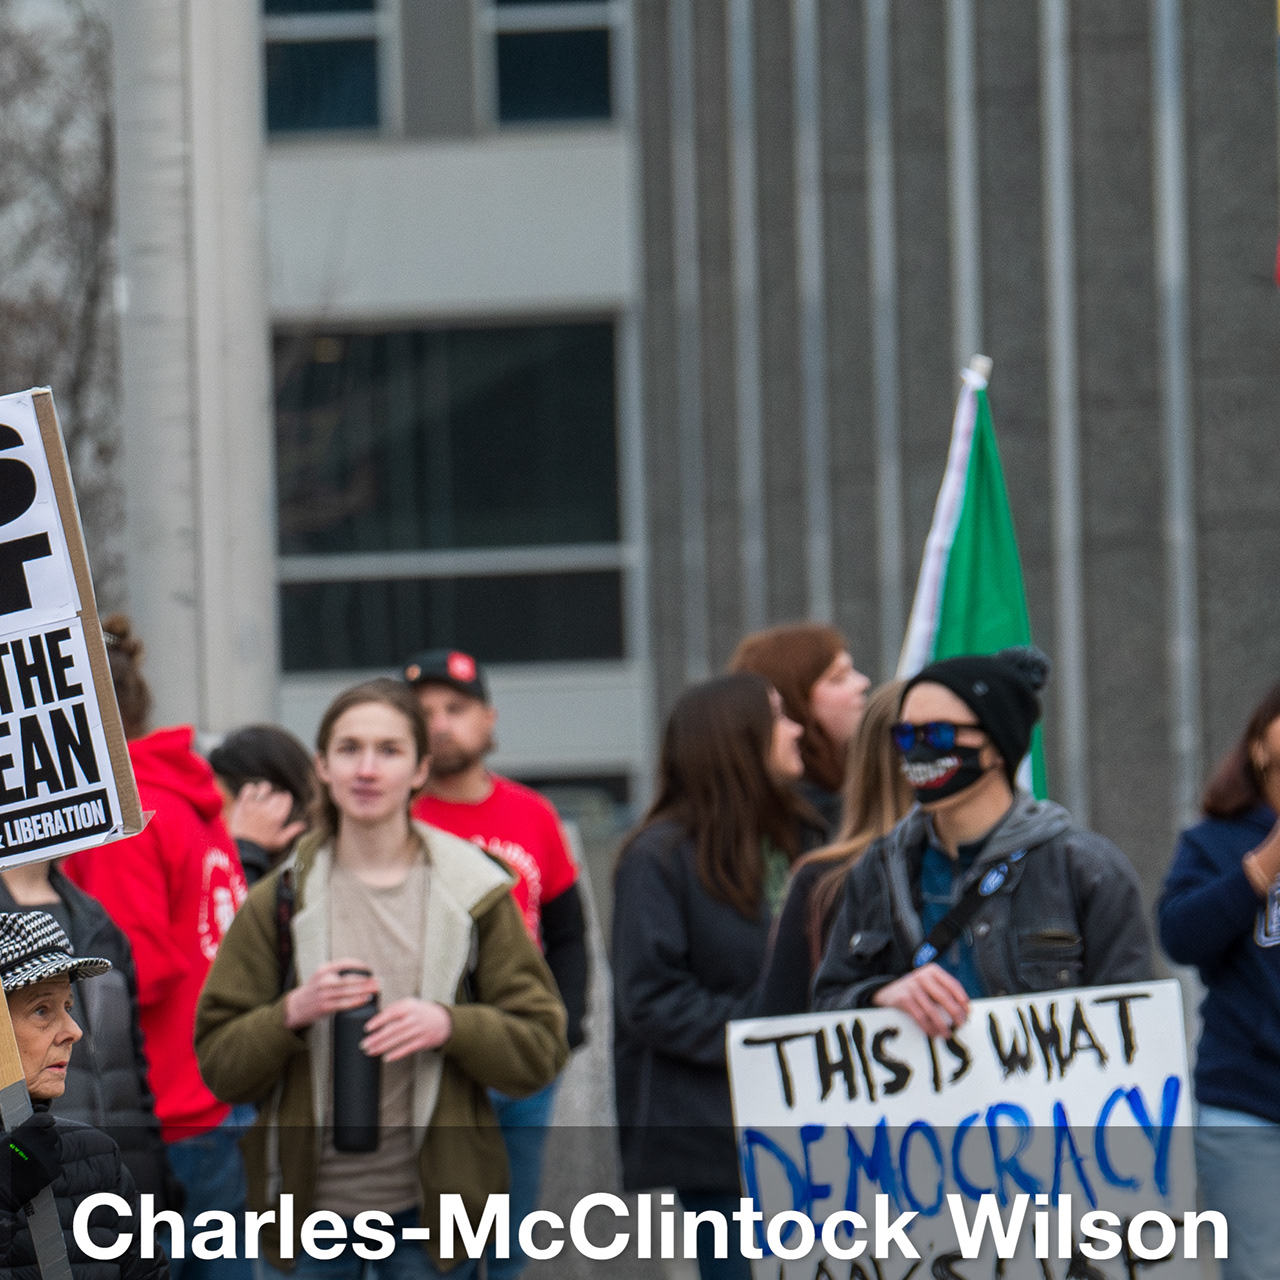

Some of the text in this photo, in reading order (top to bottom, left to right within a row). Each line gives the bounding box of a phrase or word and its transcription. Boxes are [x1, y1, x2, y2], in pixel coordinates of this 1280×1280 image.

[6, 797, 107, 847] LIBERATION
[742, 993, 1152, 1109] THIS IS WHAT
[741, 1074, 1182, 1258] DEMOCRACY
